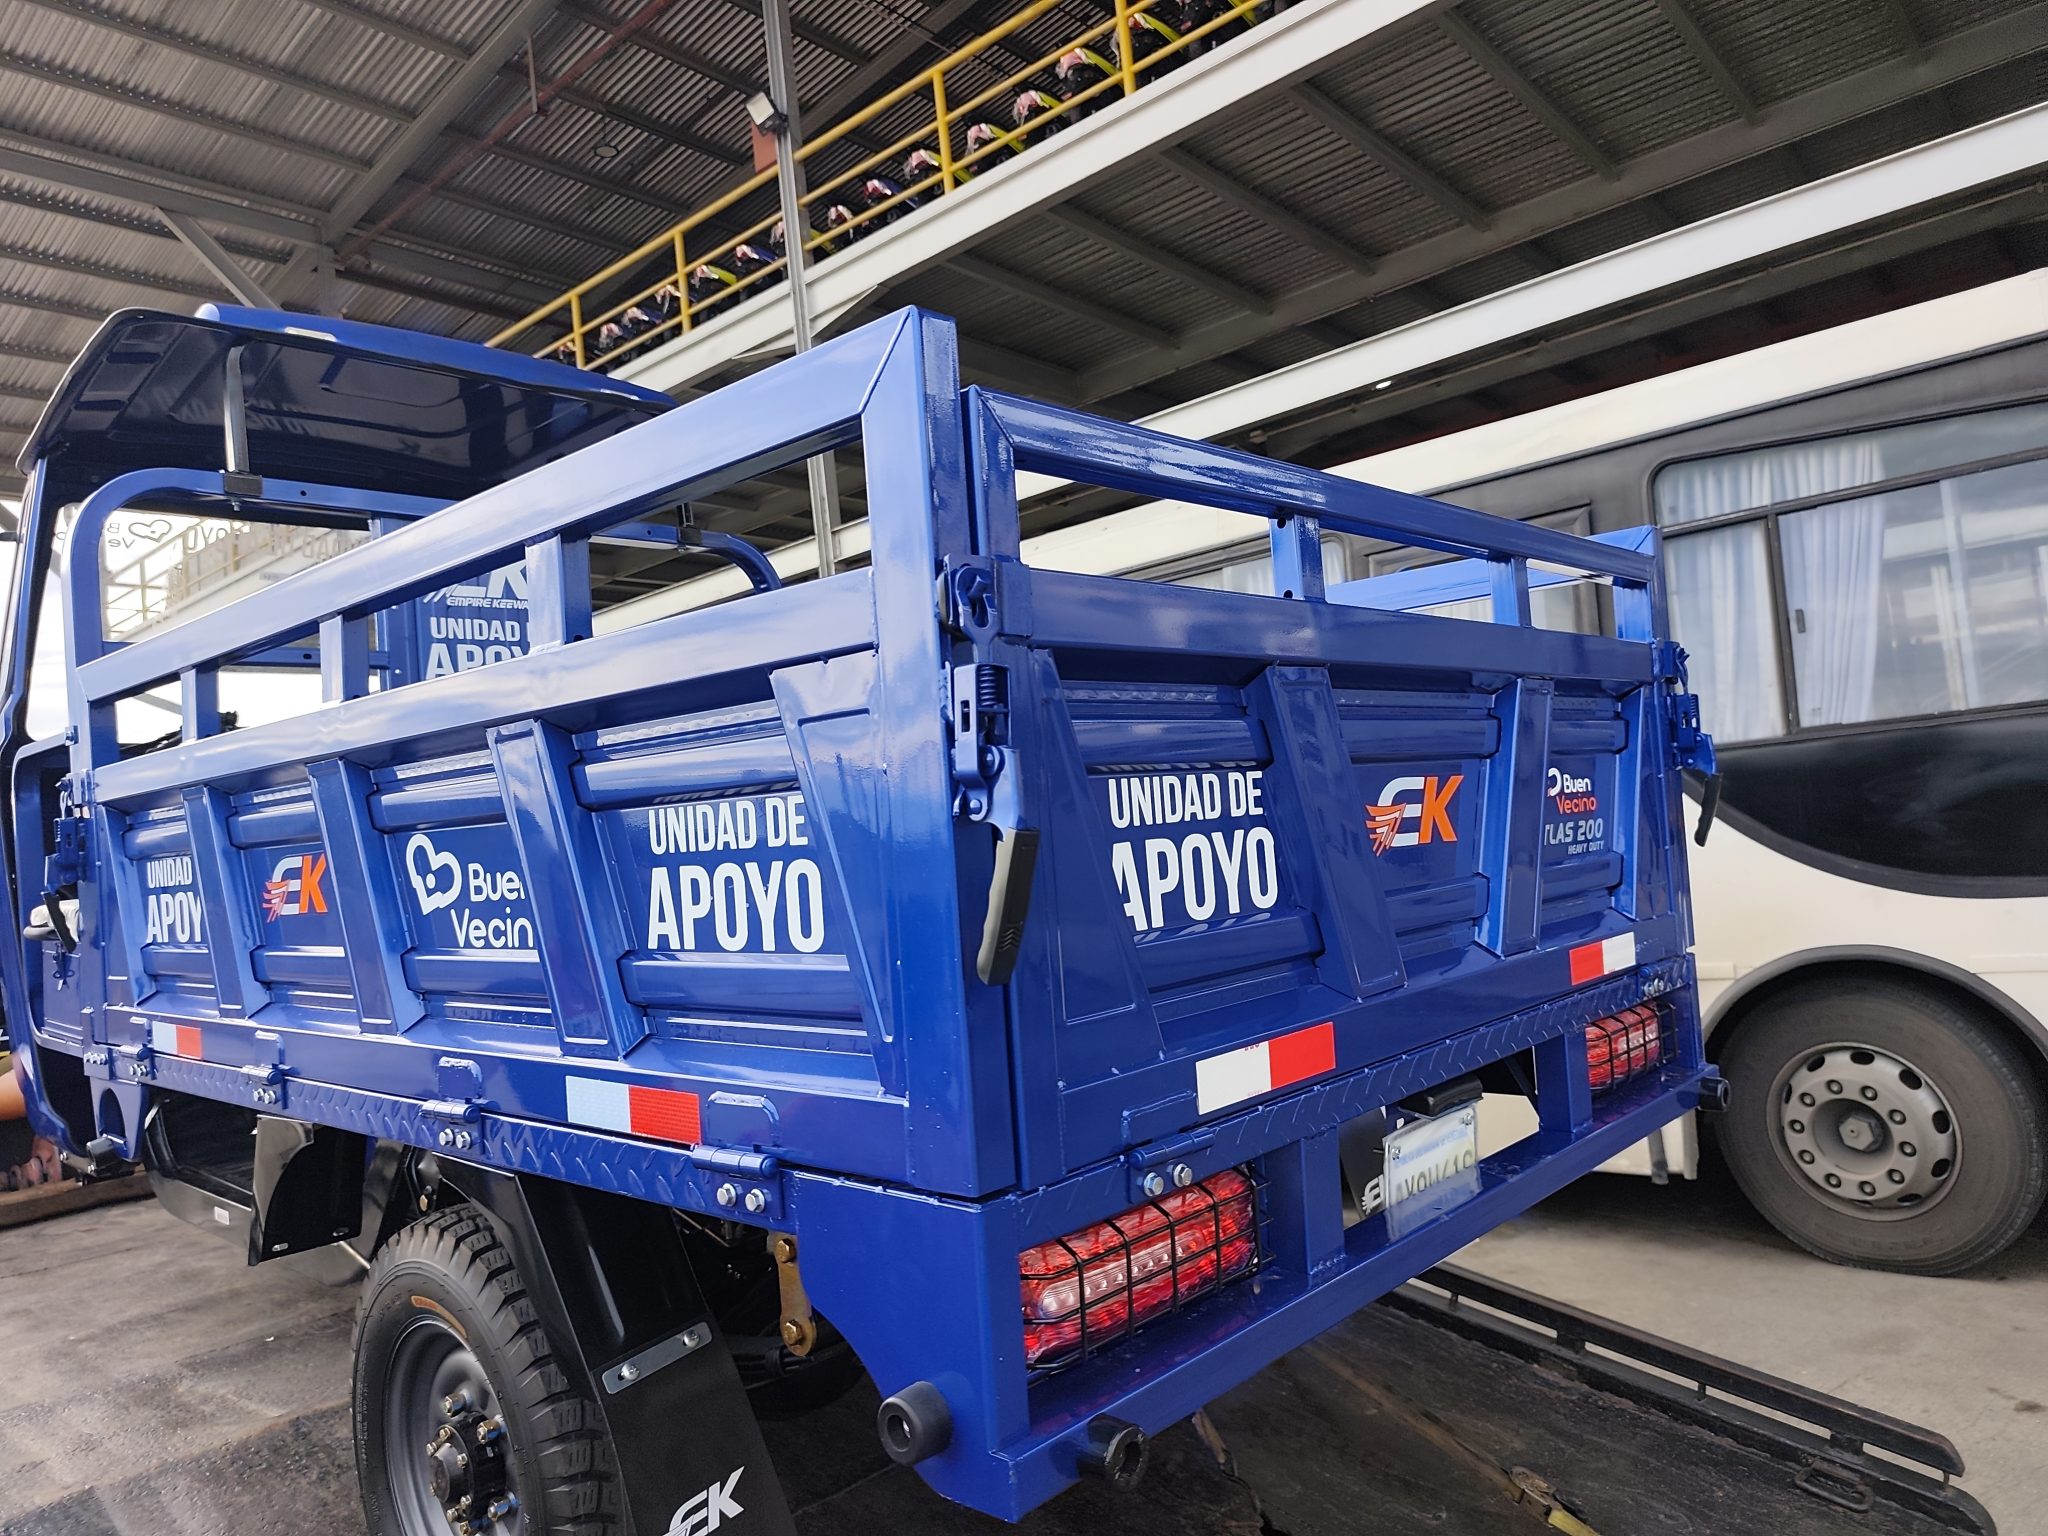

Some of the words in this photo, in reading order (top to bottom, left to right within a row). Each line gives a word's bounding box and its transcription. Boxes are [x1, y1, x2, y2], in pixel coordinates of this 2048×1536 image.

[447, 597, 492, 608] EMPIRE
[430, 617, 521, 642] UNIDAD
[1563, 773, 1592, 794] Buen
[1108, 773, 1222, 829] UNIDAD
[1228, 771, 1264, 818] DE
[1556, 793, 1597, 815] Vecino
[648, 800, 757, 855] UNIDAD
[765, 795, 808, 848] DE
[1577, 818, 1603, 841] 200
[1568, 843, 1588, 855] HEAVY
[1589, 840, 1604, 852] DUTY
[147, 856, 193, 889] UNIDAD
[1112, 826, 1278, 932] APOYO
[648, 858, 825, 953] APOYO
